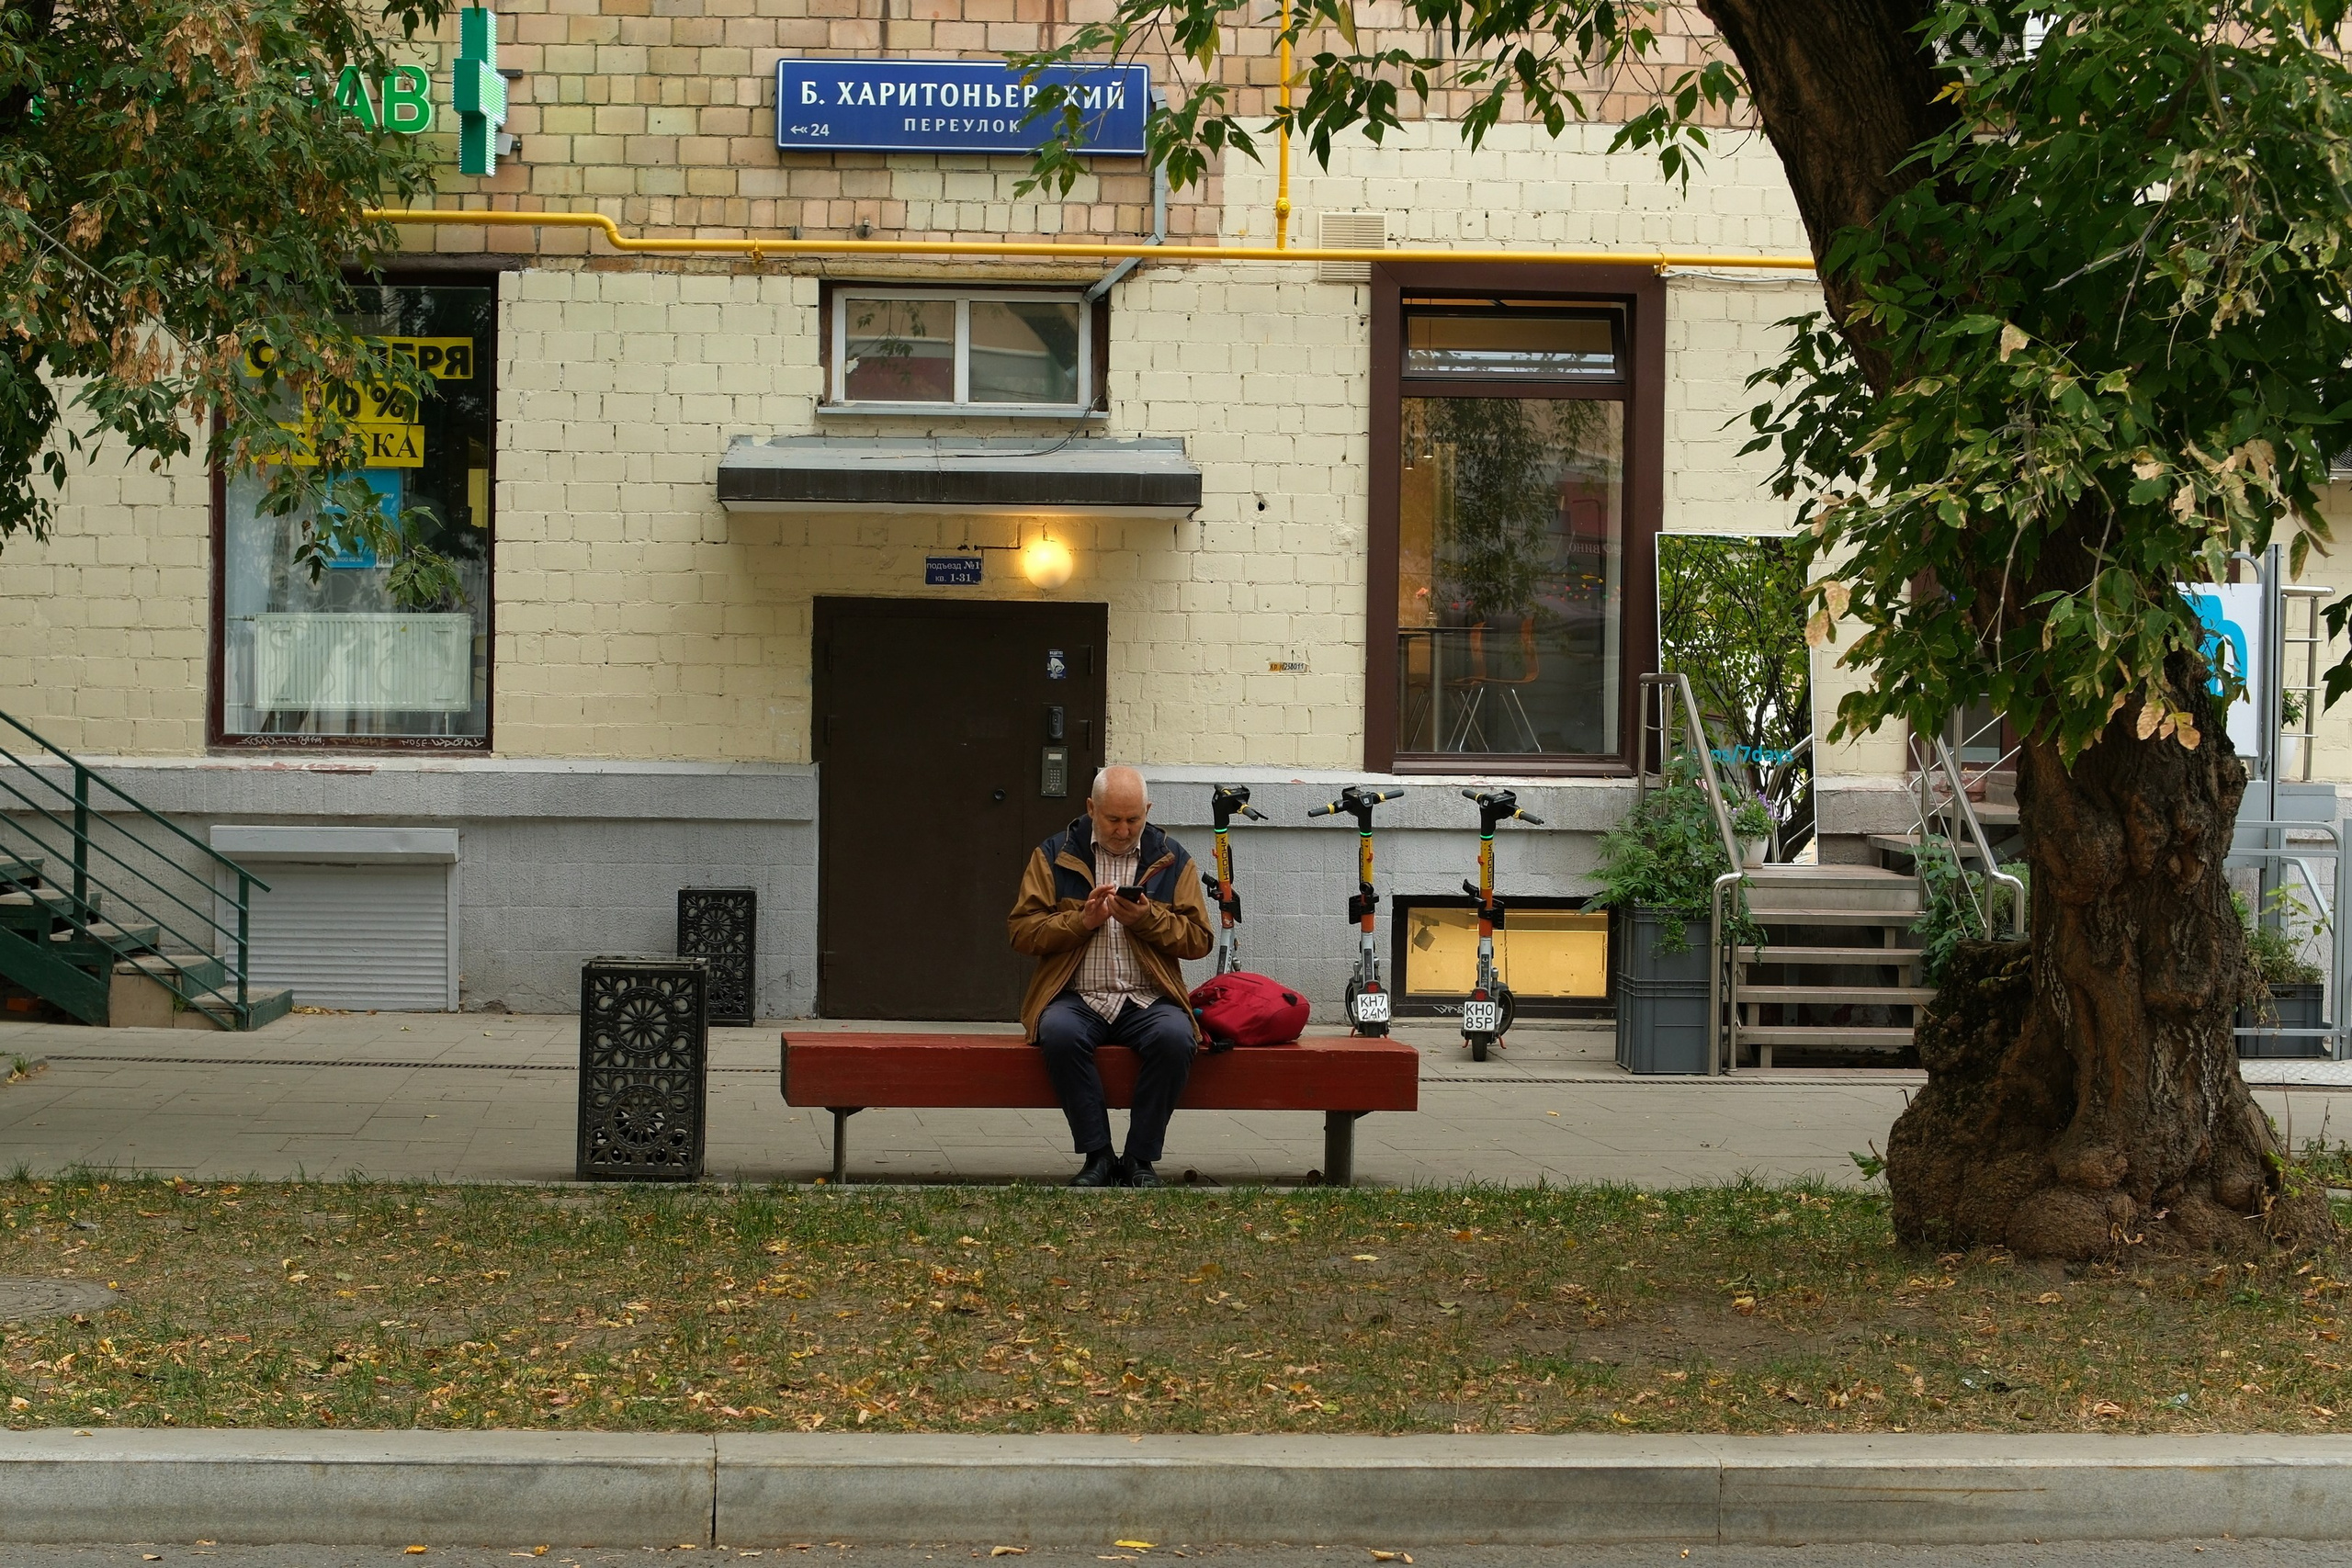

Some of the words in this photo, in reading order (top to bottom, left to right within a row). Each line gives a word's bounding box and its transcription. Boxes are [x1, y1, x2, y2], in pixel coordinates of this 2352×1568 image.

[800, 81, 826, 106] Б.
[836, 80, 1125, 110] ХАРИТОНЬЕВКИЙ
[810, 123, 830, 137] 24
[904, 118, 1022, 134] ПЕРЕУЛОК
[927, 562, 962, 570] подъезд
[1220, 835, 1229, 881] WHOOSH
